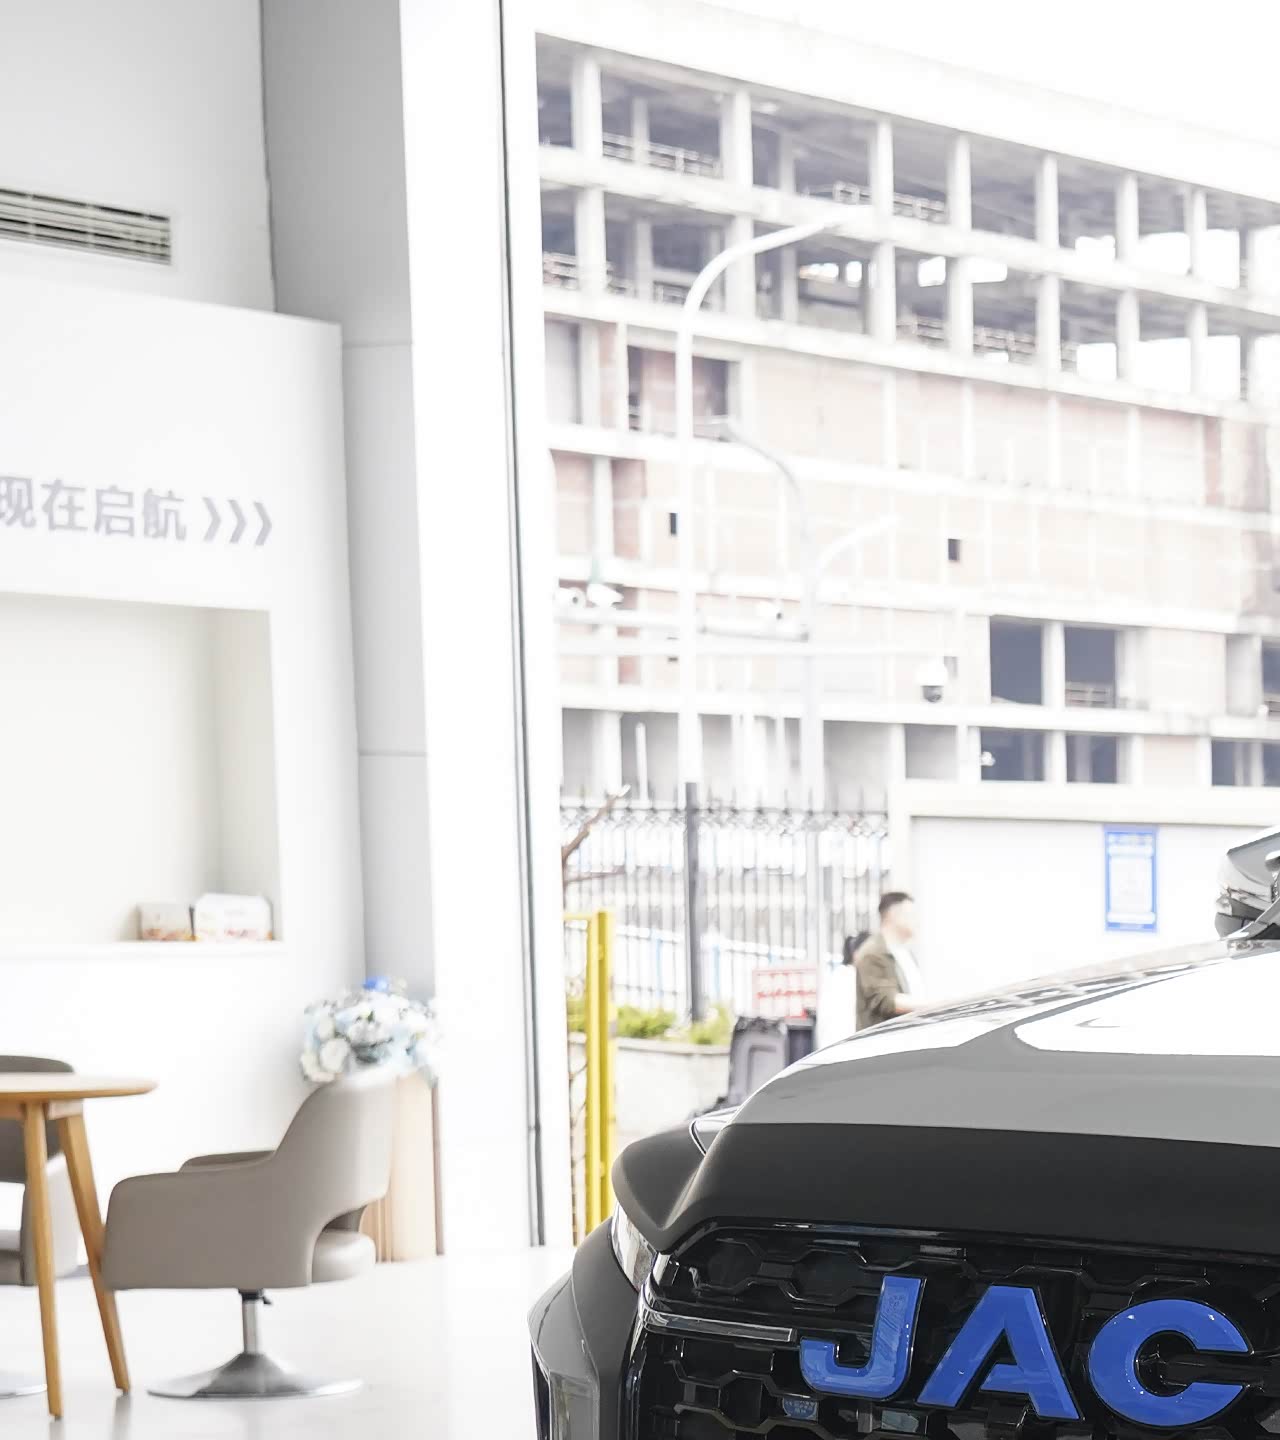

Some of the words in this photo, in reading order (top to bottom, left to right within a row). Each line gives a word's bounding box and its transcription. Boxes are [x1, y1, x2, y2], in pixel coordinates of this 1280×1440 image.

[0, 476, 187, 541] 现在启航
[799, 1274, 1254, 1428] JAC
